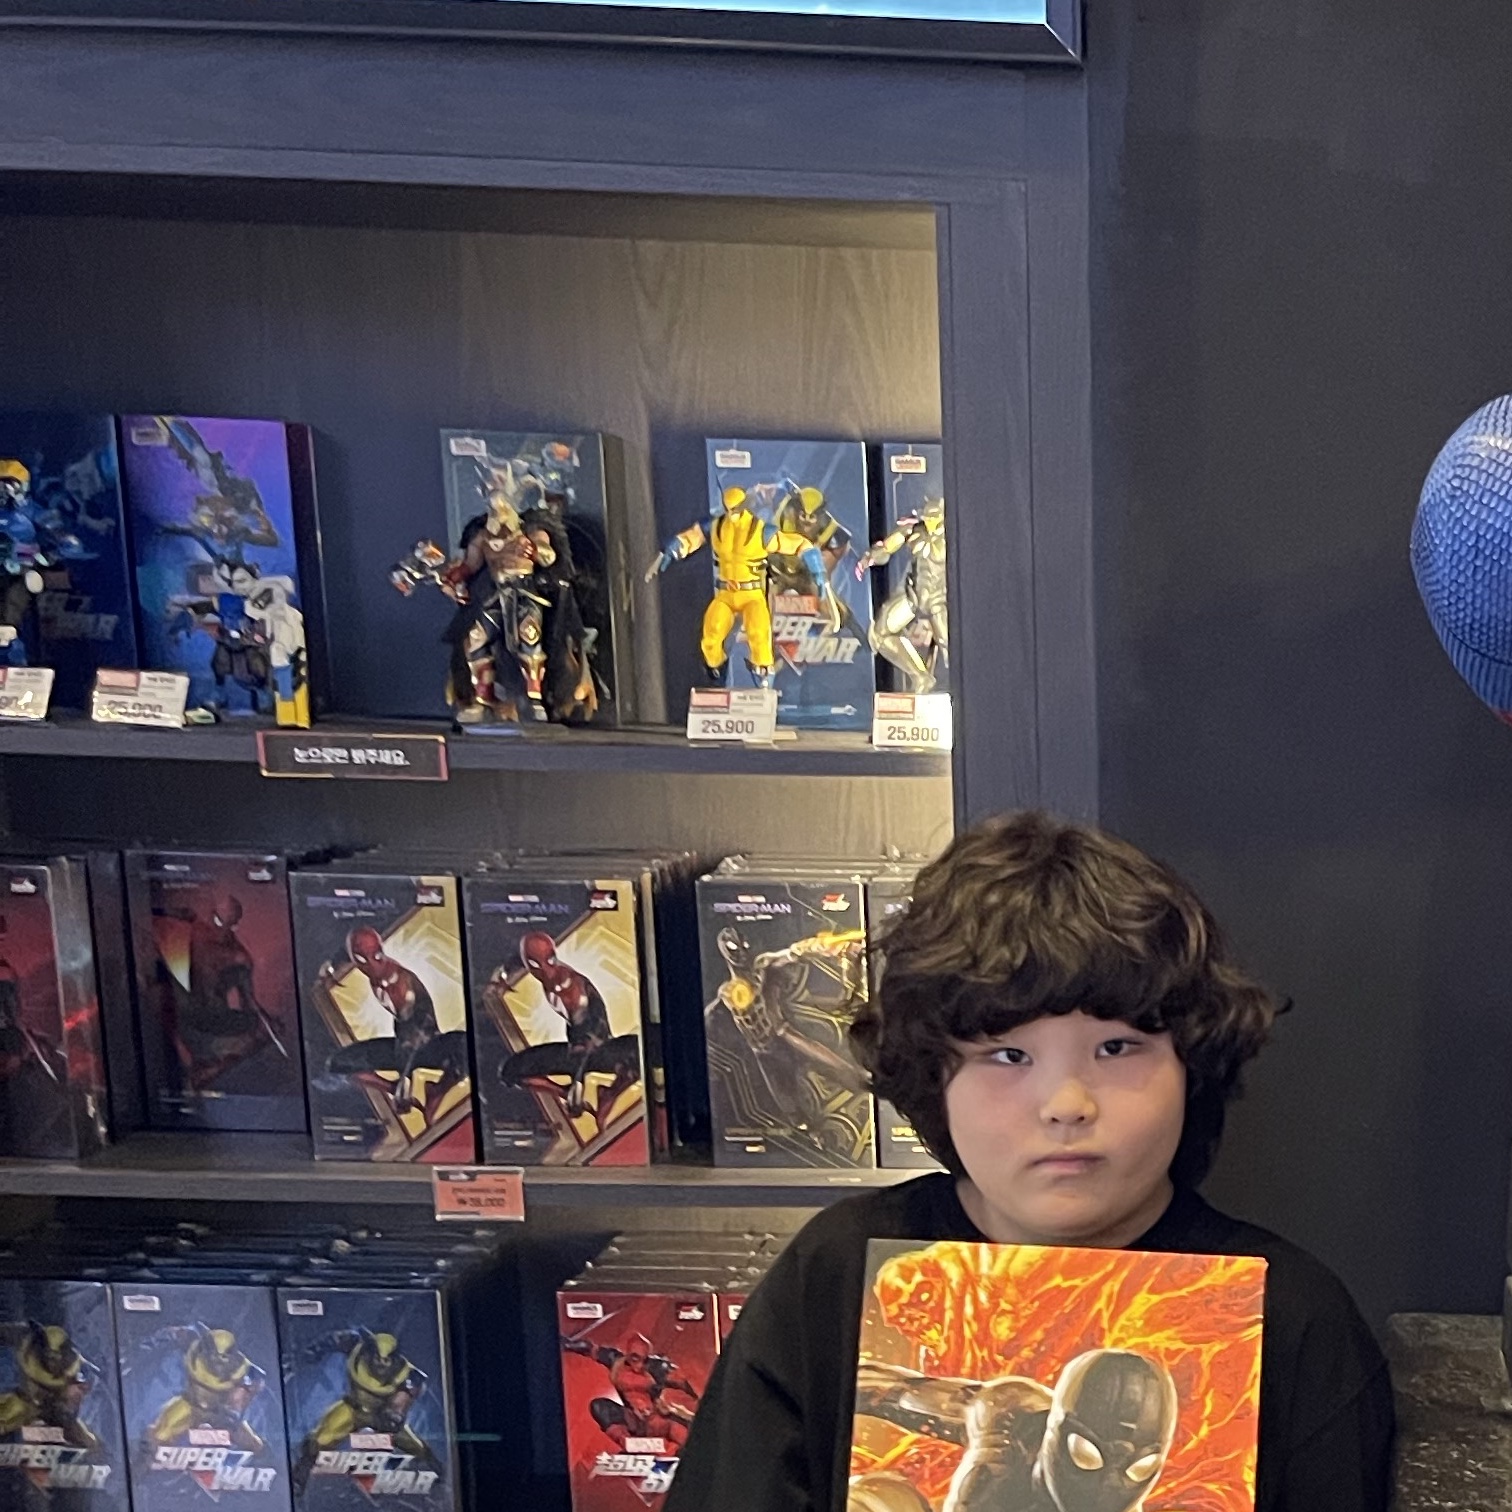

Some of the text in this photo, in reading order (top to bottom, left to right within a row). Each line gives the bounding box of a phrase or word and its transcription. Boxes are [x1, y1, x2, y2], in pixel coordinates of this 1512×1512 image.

[0, 1444, 57, 1467] UPER
[152, 1446, 222, 1470] SUPER
[312, 1451, 390, 1475] SUPER
[212, 1465, 277, 1491] WAR
[371, 1469, 439, 1494] WAR
